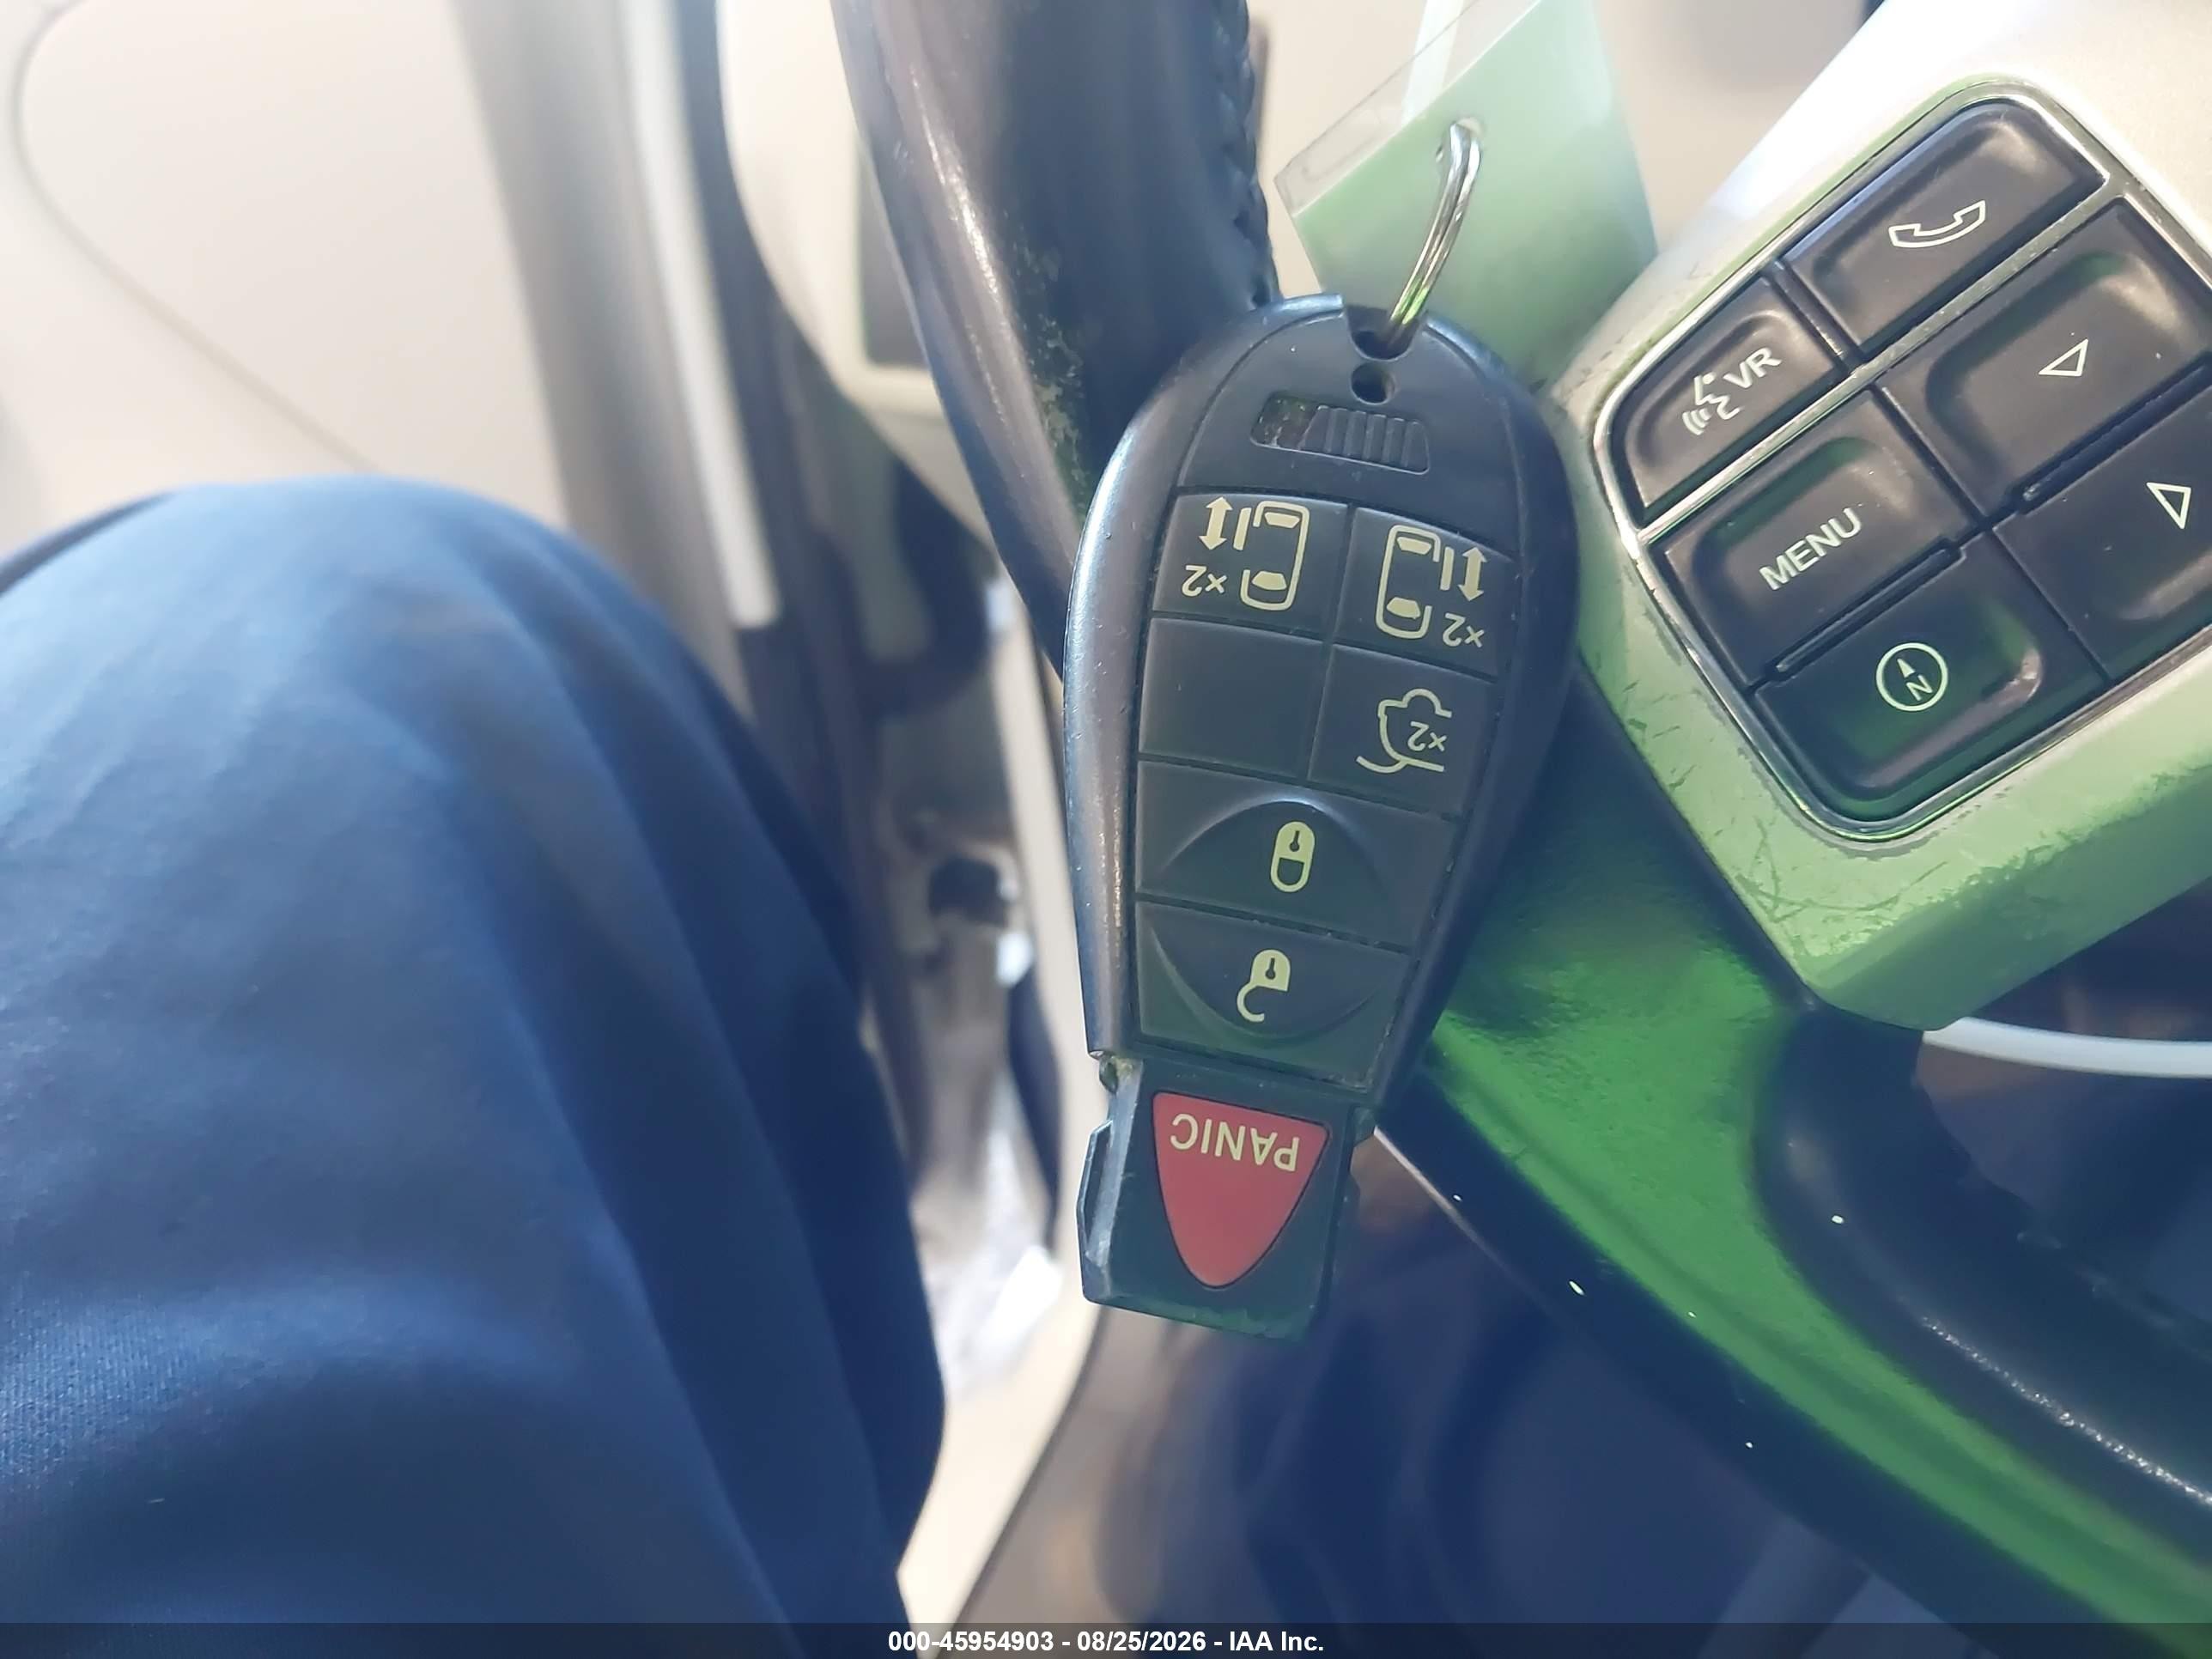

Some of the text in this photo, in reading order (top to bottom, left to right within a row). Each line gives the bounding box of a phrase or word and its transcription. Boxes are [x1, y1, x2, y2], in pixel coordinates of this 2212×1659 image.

[1724, 347, 1782, 390] VR
[1759, 507, 1862, 590] MENU
[1906, 675, 1934, 702] N
[1170, 1114, 1299, 1171] PANIC
